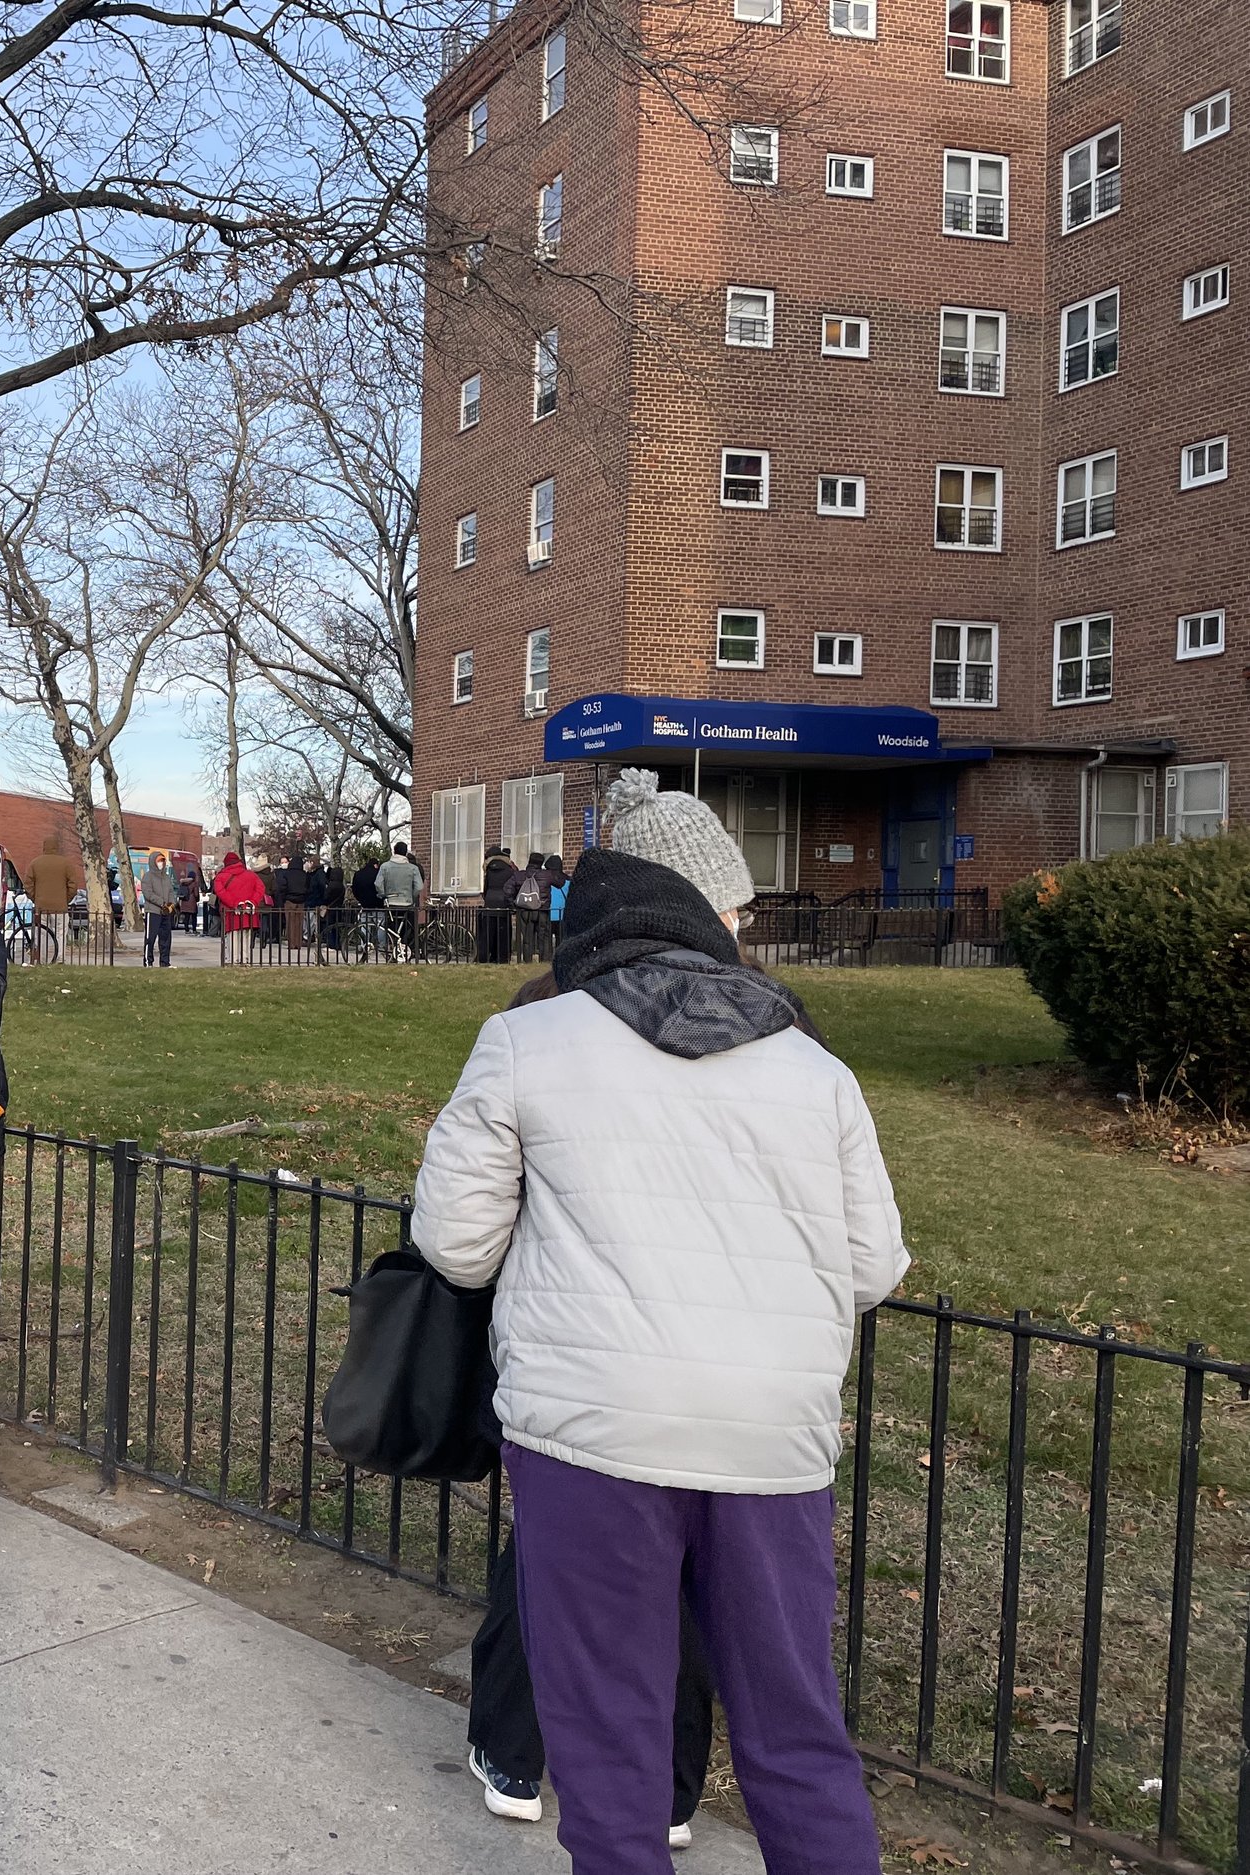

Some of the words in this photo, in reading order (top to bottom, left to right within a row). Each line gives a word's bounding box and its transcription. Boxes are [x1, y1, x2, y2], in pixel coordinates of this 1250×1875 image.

[582, 701, 602, 716] 50-53
[653, 715, 668, 723] NYC
[580, 726, 602, 738] Gotham
[602, 720, 622, 734] Health
[653, 728, 689, 737] HOSPITALS
[700, 723, 753, 739] Gotham
[755, 726, 798, 742] Health
[877, 734, 930, 748] Woodside
